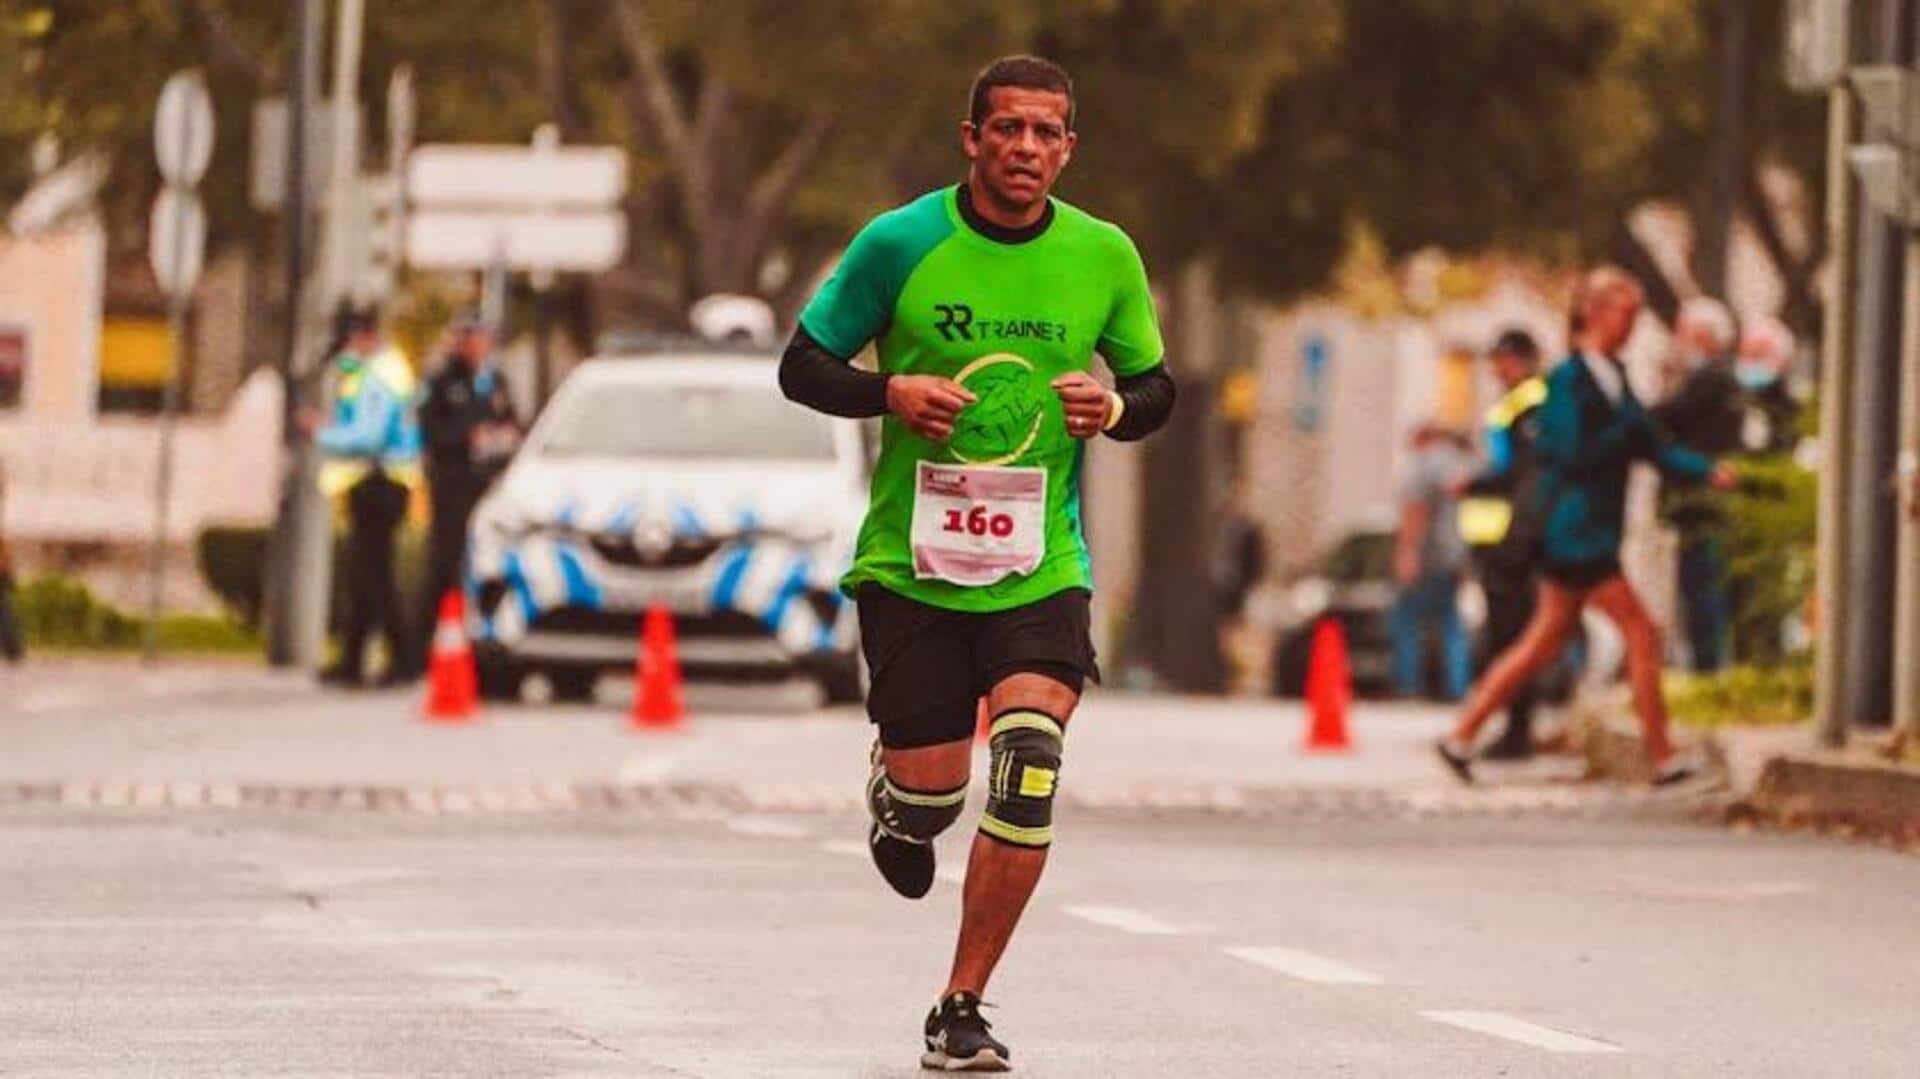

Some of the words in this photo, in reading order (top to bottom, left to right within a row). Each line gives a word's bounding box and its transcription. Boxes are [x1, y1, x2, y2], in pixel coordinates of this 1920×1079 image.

[934, 304, 973, 341] RR
[976, 320, 1066, 342] TRAINER
[943, 505, 1014, 537] 160
